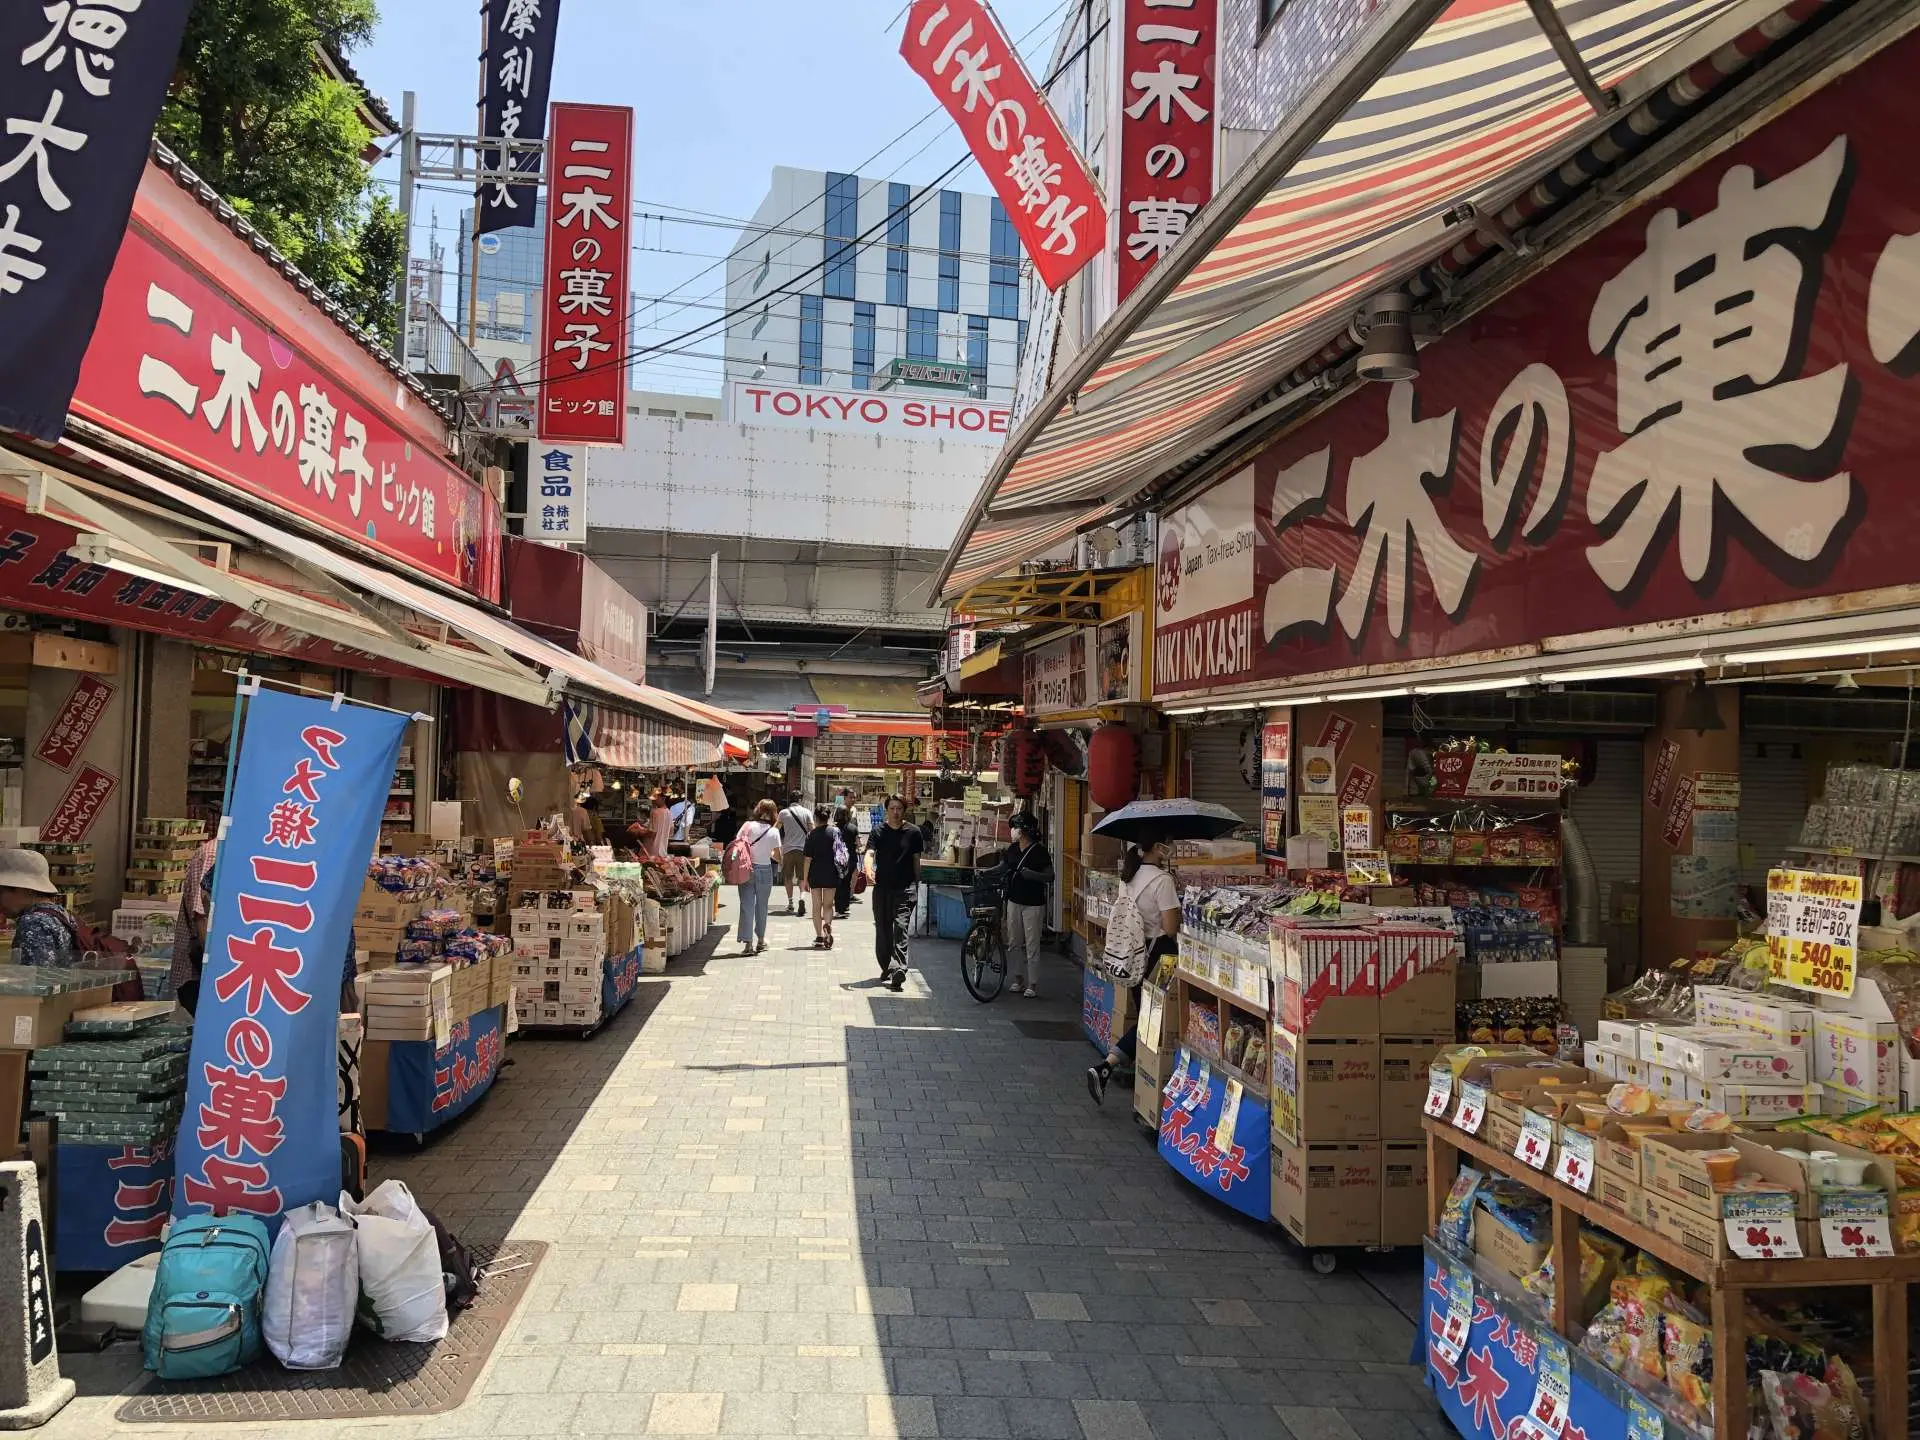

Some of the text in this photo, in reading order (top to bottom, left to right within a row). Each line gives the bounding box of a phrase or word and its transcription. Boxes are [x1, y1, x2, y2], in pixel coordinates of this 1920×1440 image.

[919, 3, 1088, 255] 二木の菓子
[553, 140, 621, 370] 二木の菓子
[138, 282, 435, 539] 二木の菓子 ビック館
[548, 398, 614, 416] ビック館
[745, 388, 888, 424] TOKYO
[541, 450, 573, 497] 食品
[1206, 537, 1235, 564] Tax-free
[1236, 530, 1254, 553] Shop
[1156, 609, 1252, 685] NIKI NO KASHI
[49, 782, 88, 842] スミマセン
[1796, 917, 1852, 938] ももゼリーBOX
[1803, 906, 1847, 921] 果汁100%の
[1104, 961, 1131, 978] FILA
[432, 1026, 499, 1113] 二木の菓子
